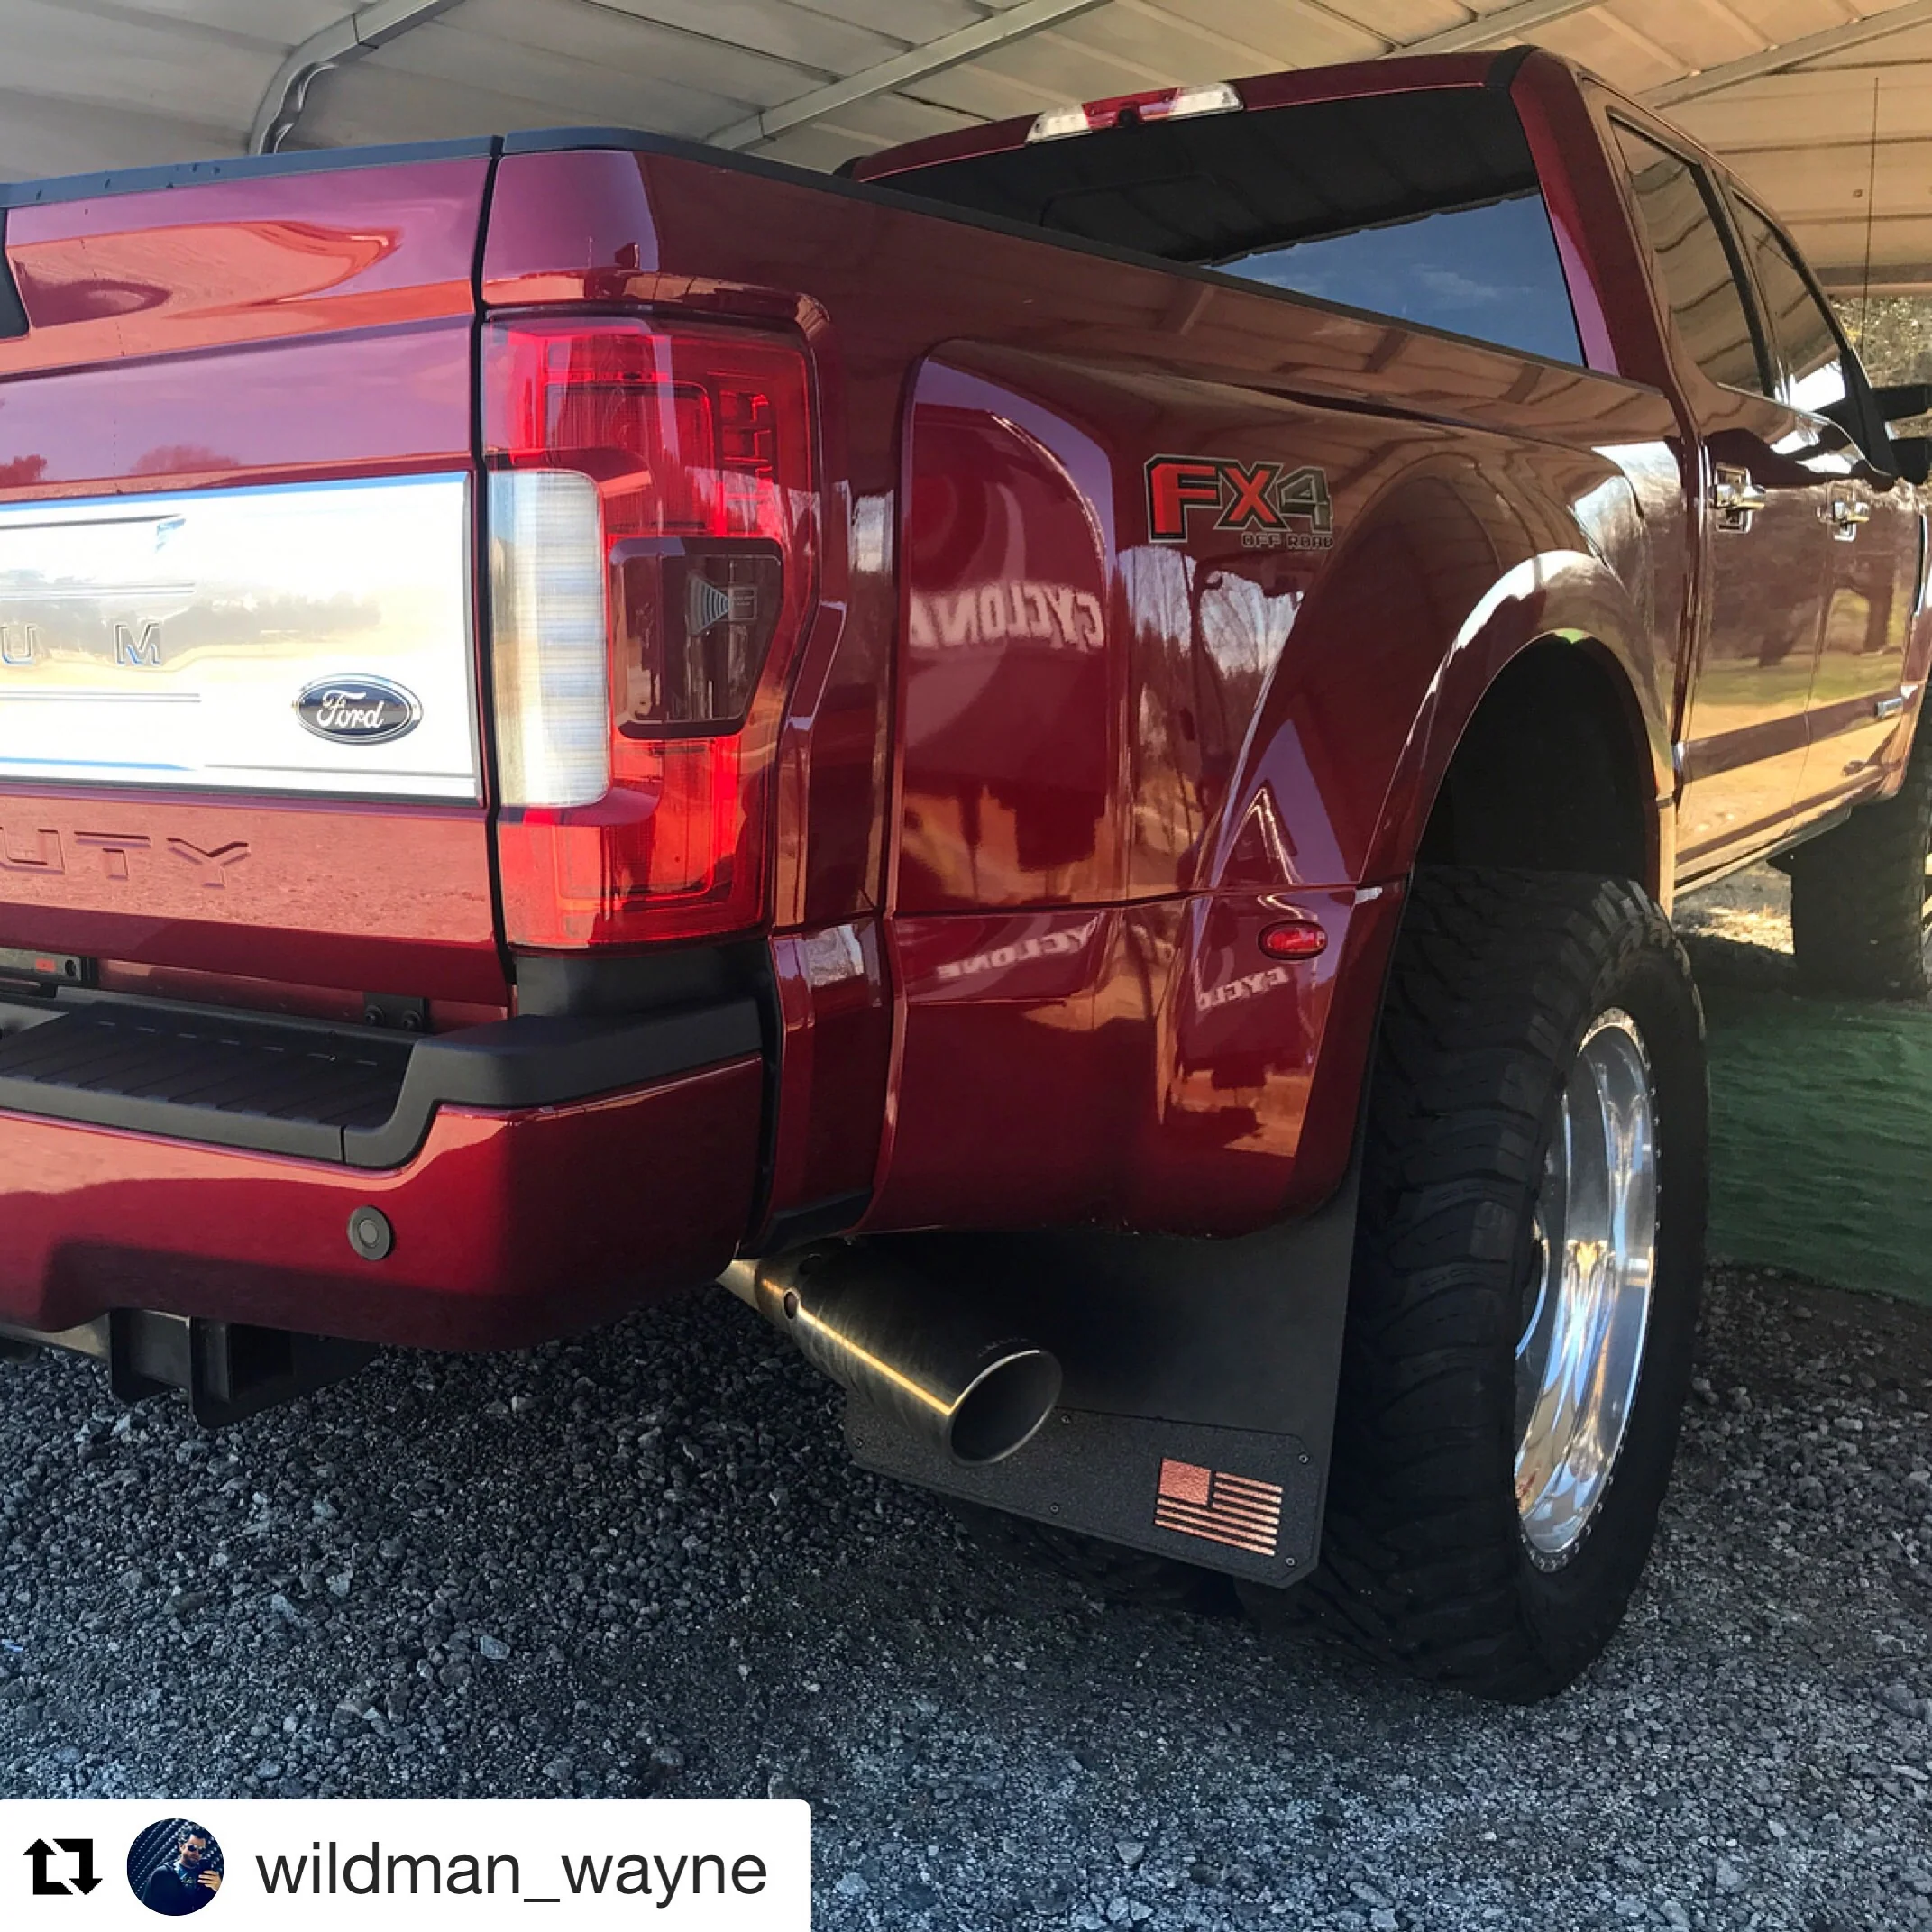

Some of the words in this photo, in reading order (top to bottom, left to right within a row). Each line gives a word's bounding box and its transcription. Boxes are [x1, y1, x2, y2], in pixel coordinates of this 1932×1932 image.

[1144, 453, 1333, 543] FX4
[1241, 532, 1281, 548] OFF
[1286, 533, 1333, 549] ROAD
[316, 689, 385, 728] Ford
